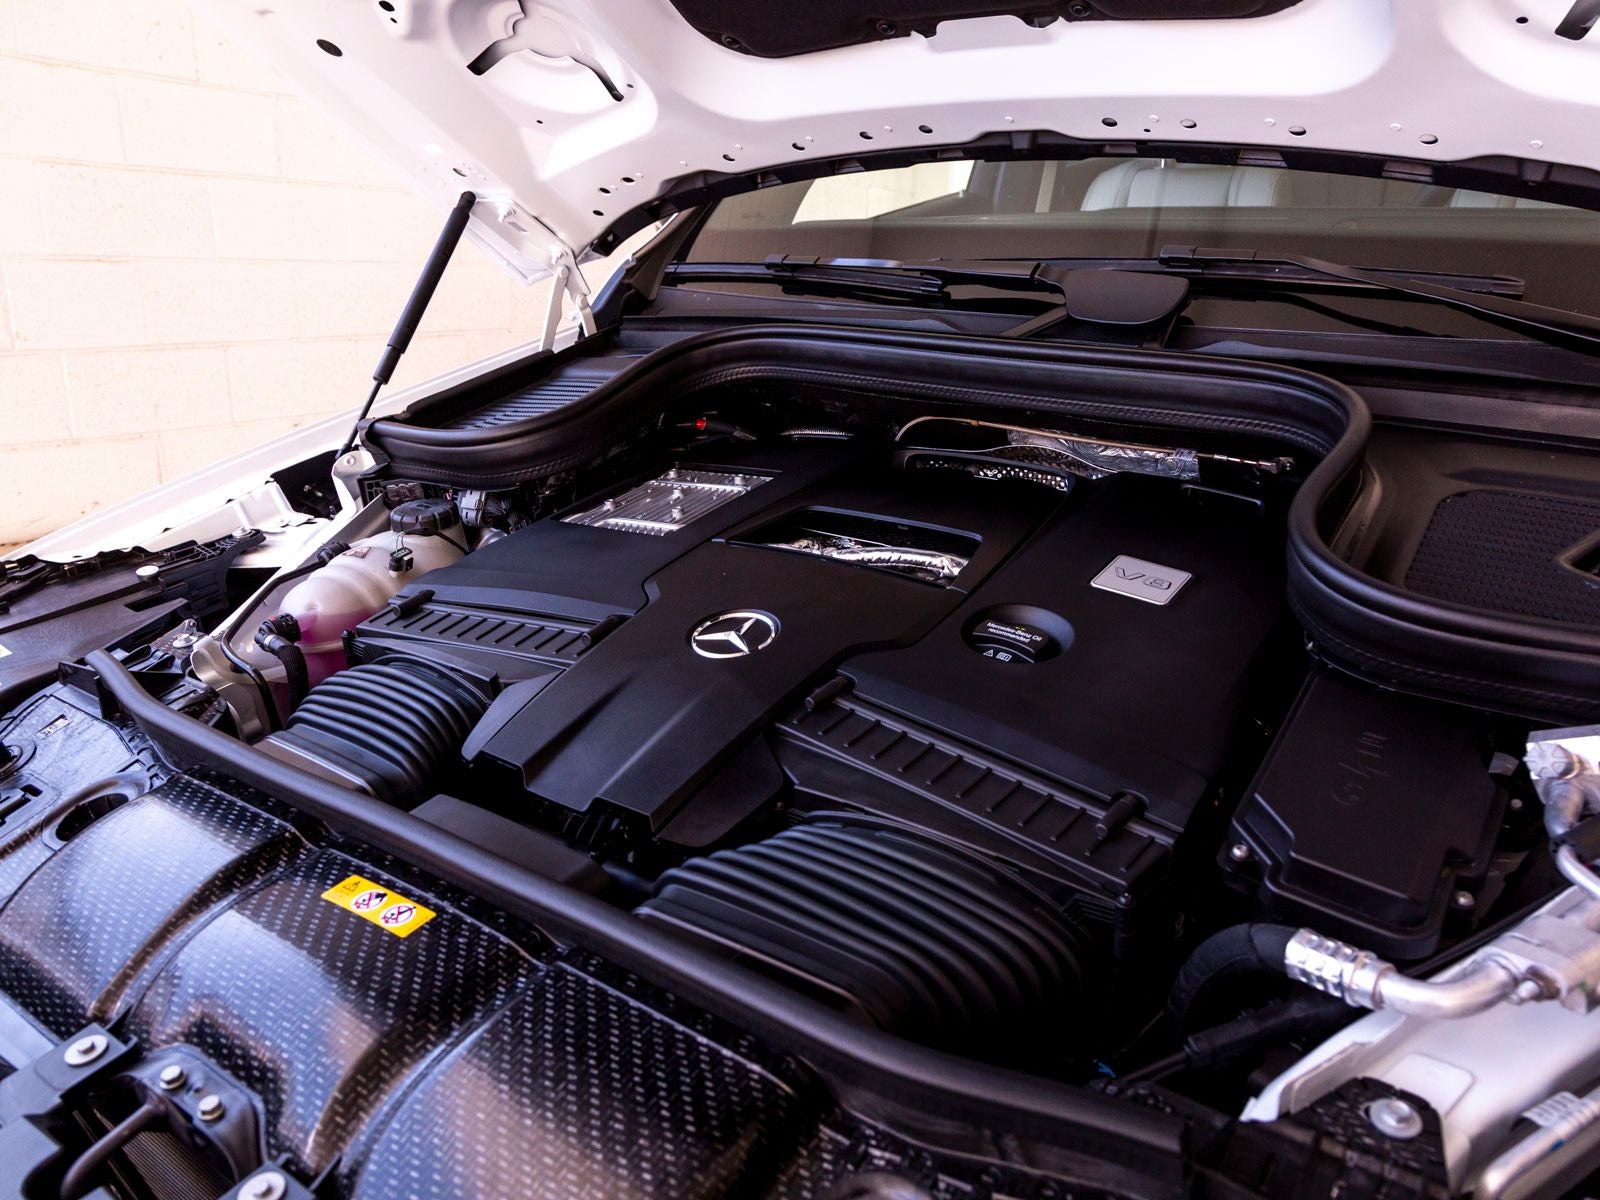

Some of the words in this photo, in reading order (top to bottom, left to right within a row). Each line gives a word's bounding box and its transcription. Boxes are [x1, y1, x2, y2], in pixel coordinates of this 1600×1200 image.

[1115, 566, 1172, 590] V8
[986, 622, 1032, 638] Mercedes-Benz
[988, 628, 1031, 643] recommended
